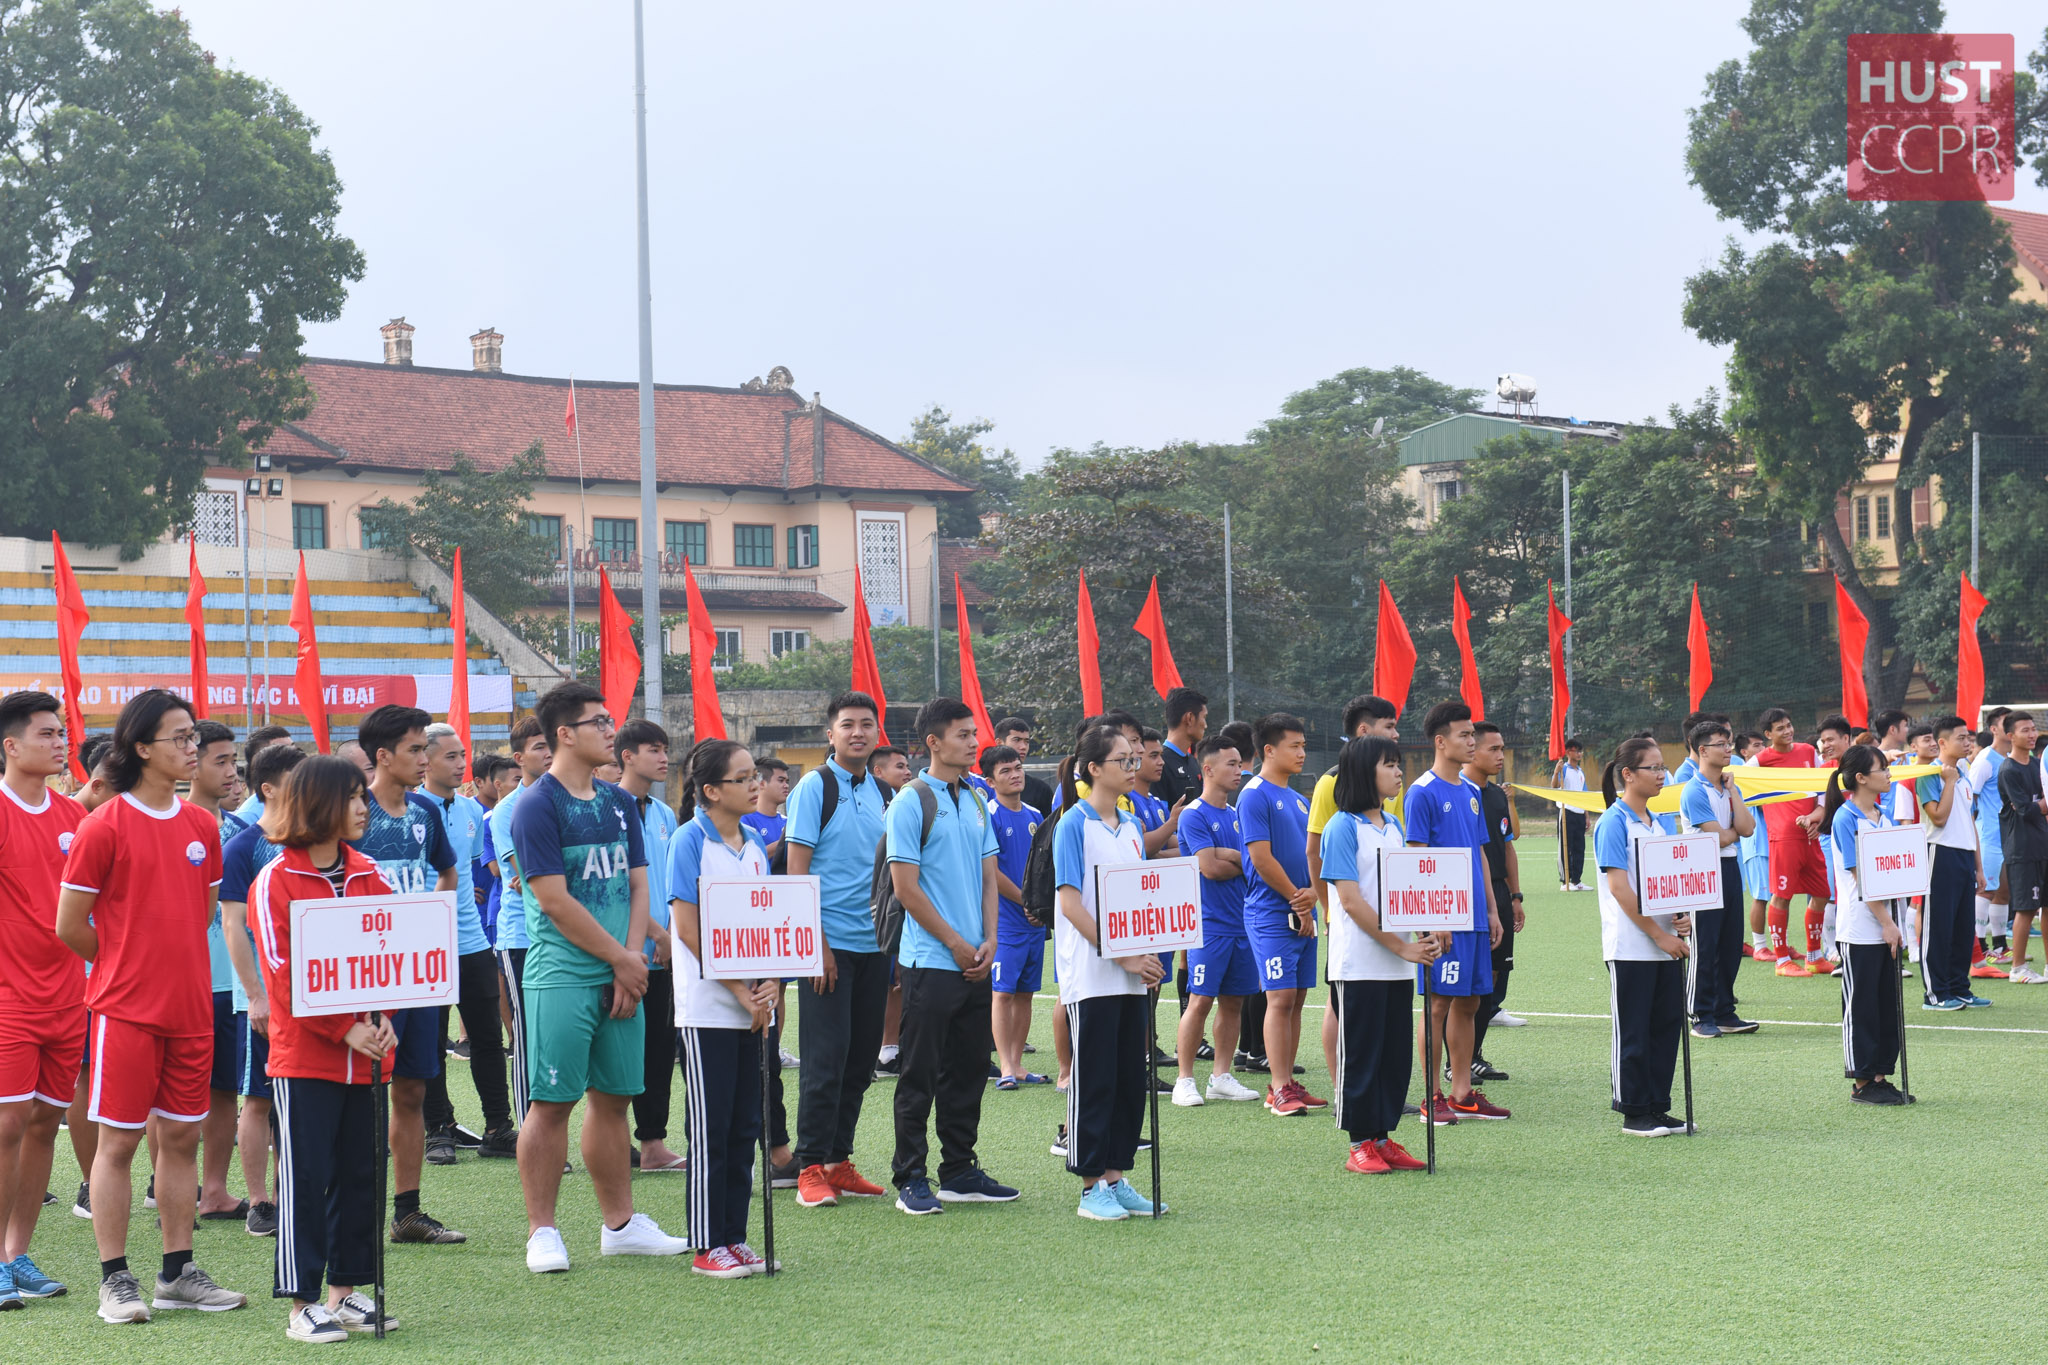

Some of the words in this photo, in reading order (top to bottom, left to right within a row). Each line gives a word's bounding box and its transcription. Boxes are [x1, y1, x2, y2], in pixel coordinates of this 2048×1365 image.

[343, 686, 375, 708] ĐẠI
[582, 845, 629, 880] AIA
[1673, 842, 1688, 861] ĐỘI
[1875, 854, 1901, 874] TRỌNG
[1903, 850, 1916, 868] TÀI
[1419, 856, 1436, 877] ĐỘI
[1141, 871, 1160, 893] ĐỘI
[1647, 876, 1658, 900] ĐH
[1660, 874, 1679, 899] GIAO
[1680, 867, 1706, 896] THÔNG
[1707, 870, 1716, 894] VT
[1778, 875, 1788, 890] 3
[751, 886, 773, 911] ĐỘI
[1388, 890, 1400, 915] HV
[1402, 884, 1426, 915] NÔNG
[1428, 884, 1454, 920] NGIỆP
[1456, 890, 1468, 914] VN
[361, 908, 392, 936] ĐỘI
[1108, 911, 1128, 940] ĐH
[1132, 902, 1166, 942] ĐIỆN
[1169, 902, 1196, 938] LỰC
[712, 928, 732, 959] ĐH
[736, 927, 771, 958] KINH
[774, 916, 791, 957] TẾ
[795, 926, 814, 960] QD
[307, 957, 339, 993] ĐH
[347, 939, 405, 990] THỦY
[412, 947, 447, 991] LỢI
[1265, 956, 1284, 981] 13
[1441, 960, 1460, 985] 15
